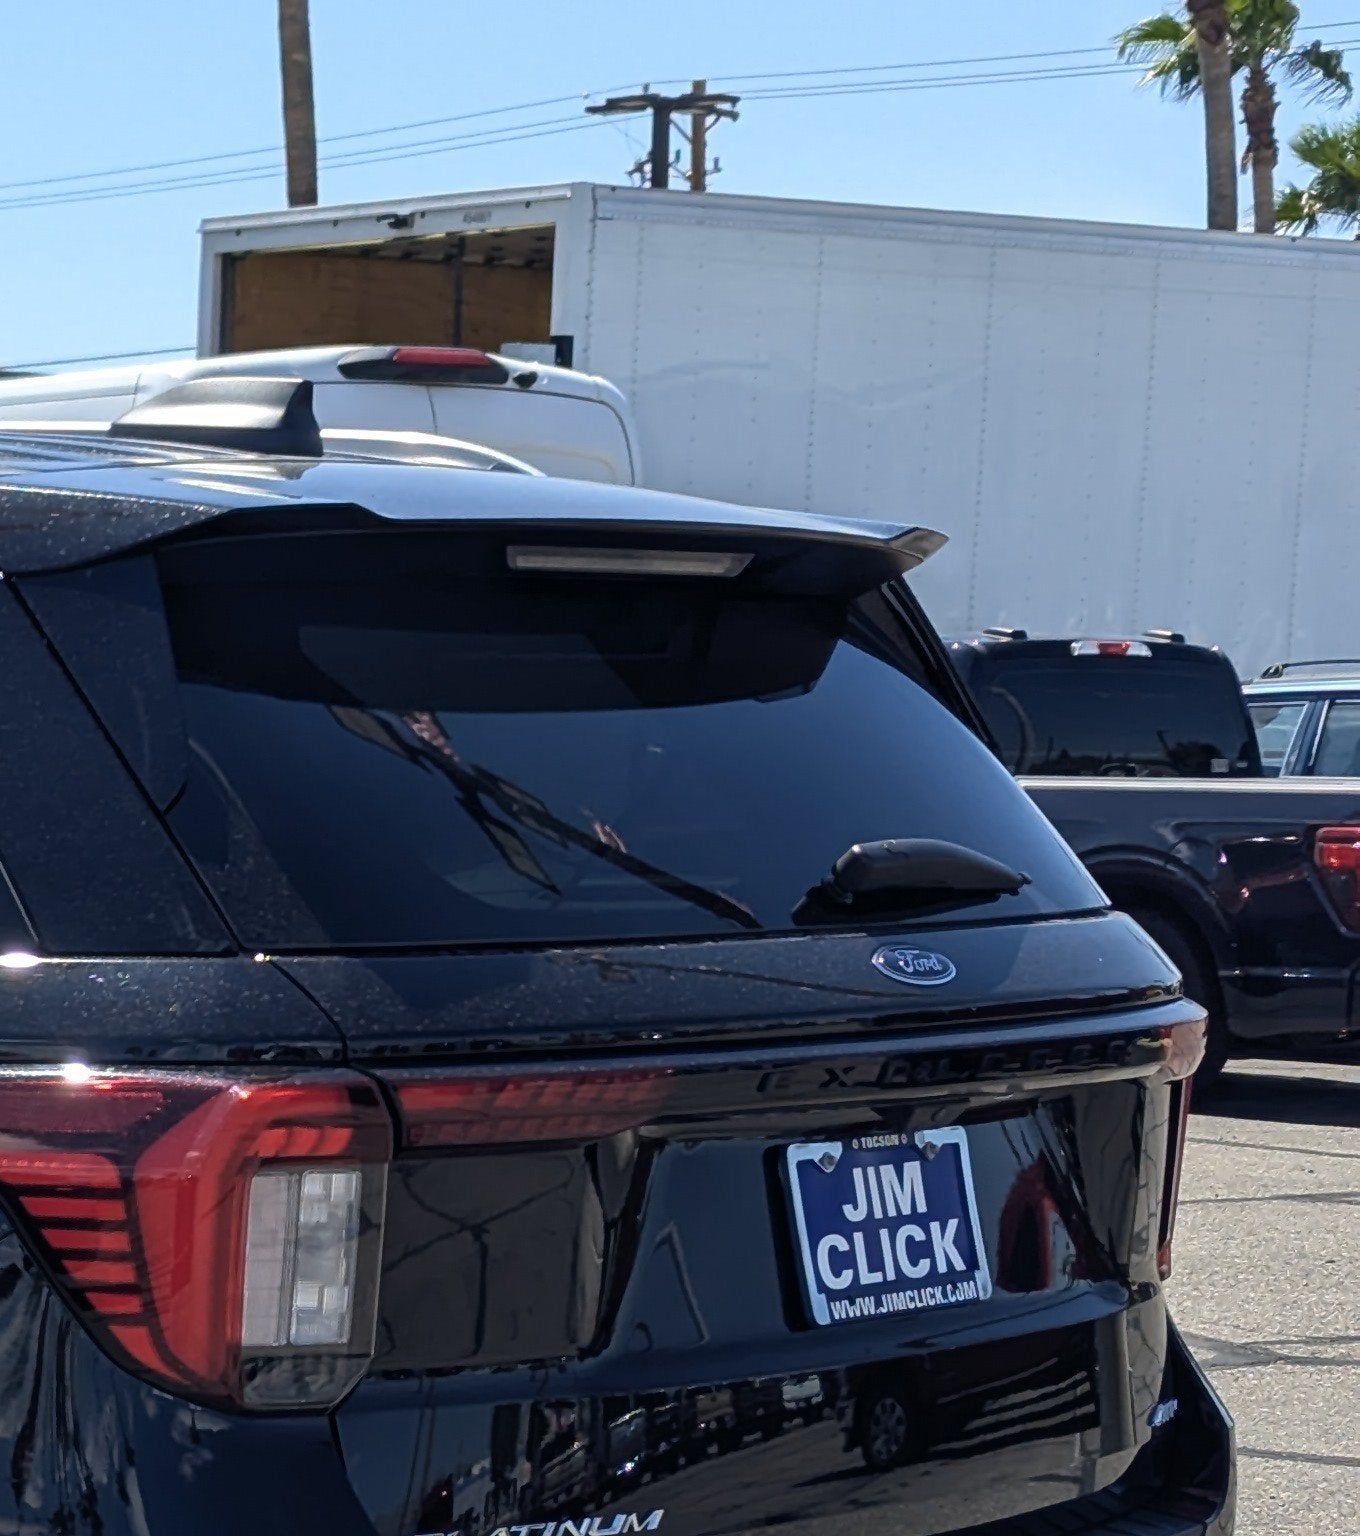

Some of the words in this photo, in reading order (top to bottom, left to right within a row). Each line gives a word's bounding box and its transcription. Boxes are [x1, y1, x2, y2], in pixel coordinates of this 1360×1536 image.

[895, 949, 942, 973] Ford
[842, 1160, 928, 1222] JIM
[817, 1218, 967, 1290] CLICK
[830, 1280, 979, 1321] WWW.JIMCLICK.COM
